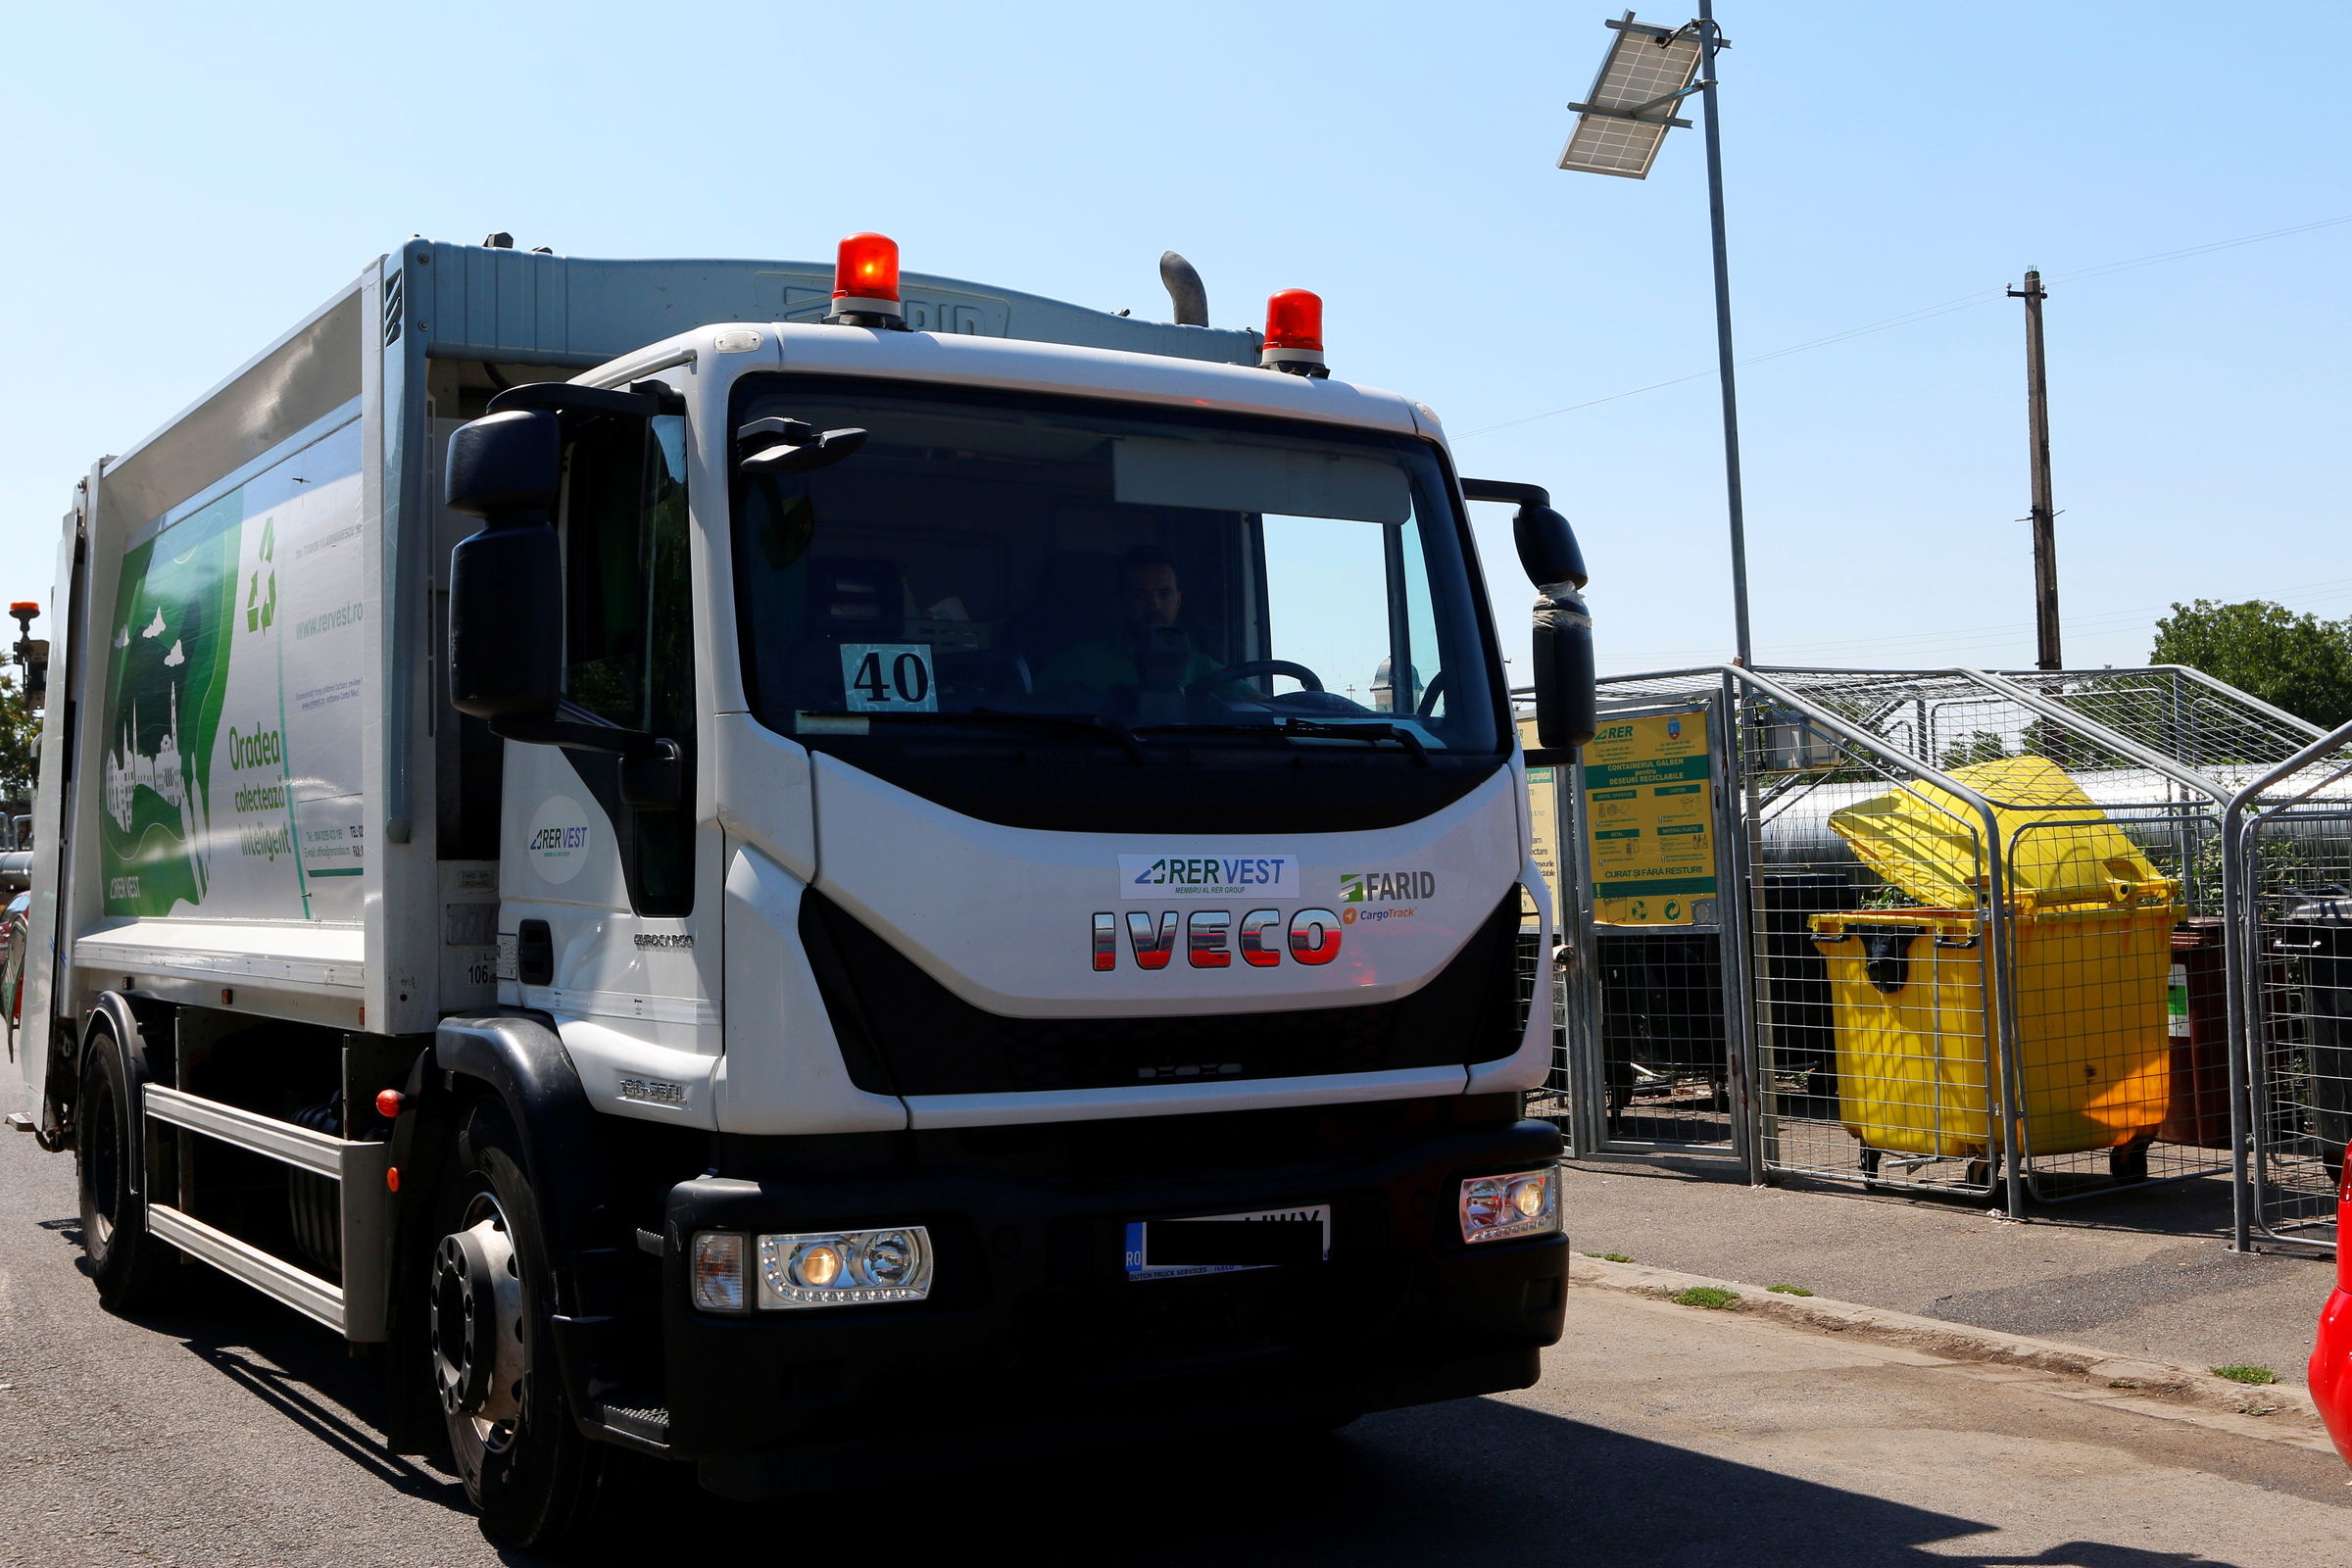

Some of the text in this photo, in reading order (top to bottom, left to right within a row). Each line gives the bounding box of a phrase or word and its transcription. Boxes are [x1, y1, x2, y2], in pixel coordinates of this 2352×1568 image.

[296, 602, 363, 641] www.rervest.ro
[853, 651, 930, 704] 40
[1608, 725, 1634, 739] RER
[229, 721, 280, 771] Oradea
[1607, 758, 1684, 772] CONTAINERUL GALBEN
[1635, 768, 1656, 777] pentru
[1640, 771, 1684, 783] RECICLABILE
[234, 774, 285, 813] colectează
[238, 821, 292, 862] inteligent
[542, 826, 588, 850] RER VEST
[1169, 858, 1285, 884] RER VEST
[1605, 869, 1633, 879] CURAT
[1175, 886, 1201, 895] MEMBRU
[1201, 886, 1210, 895] AL
[1366, 871, 1436, 902] FARID
[1360, 906, 1415, 921] CargoTrack
[1092, 907, 1343, 972] IVECO
[468, 964, 489, 984] 106
[1126, 1250, 1142, 1267] RO
[1130, 1272, 1152, 1281] DUTCH
[1153, 1270, 1176, 1279] TRUCK
[1176, 1266, 1208, 1277] SERVICES
